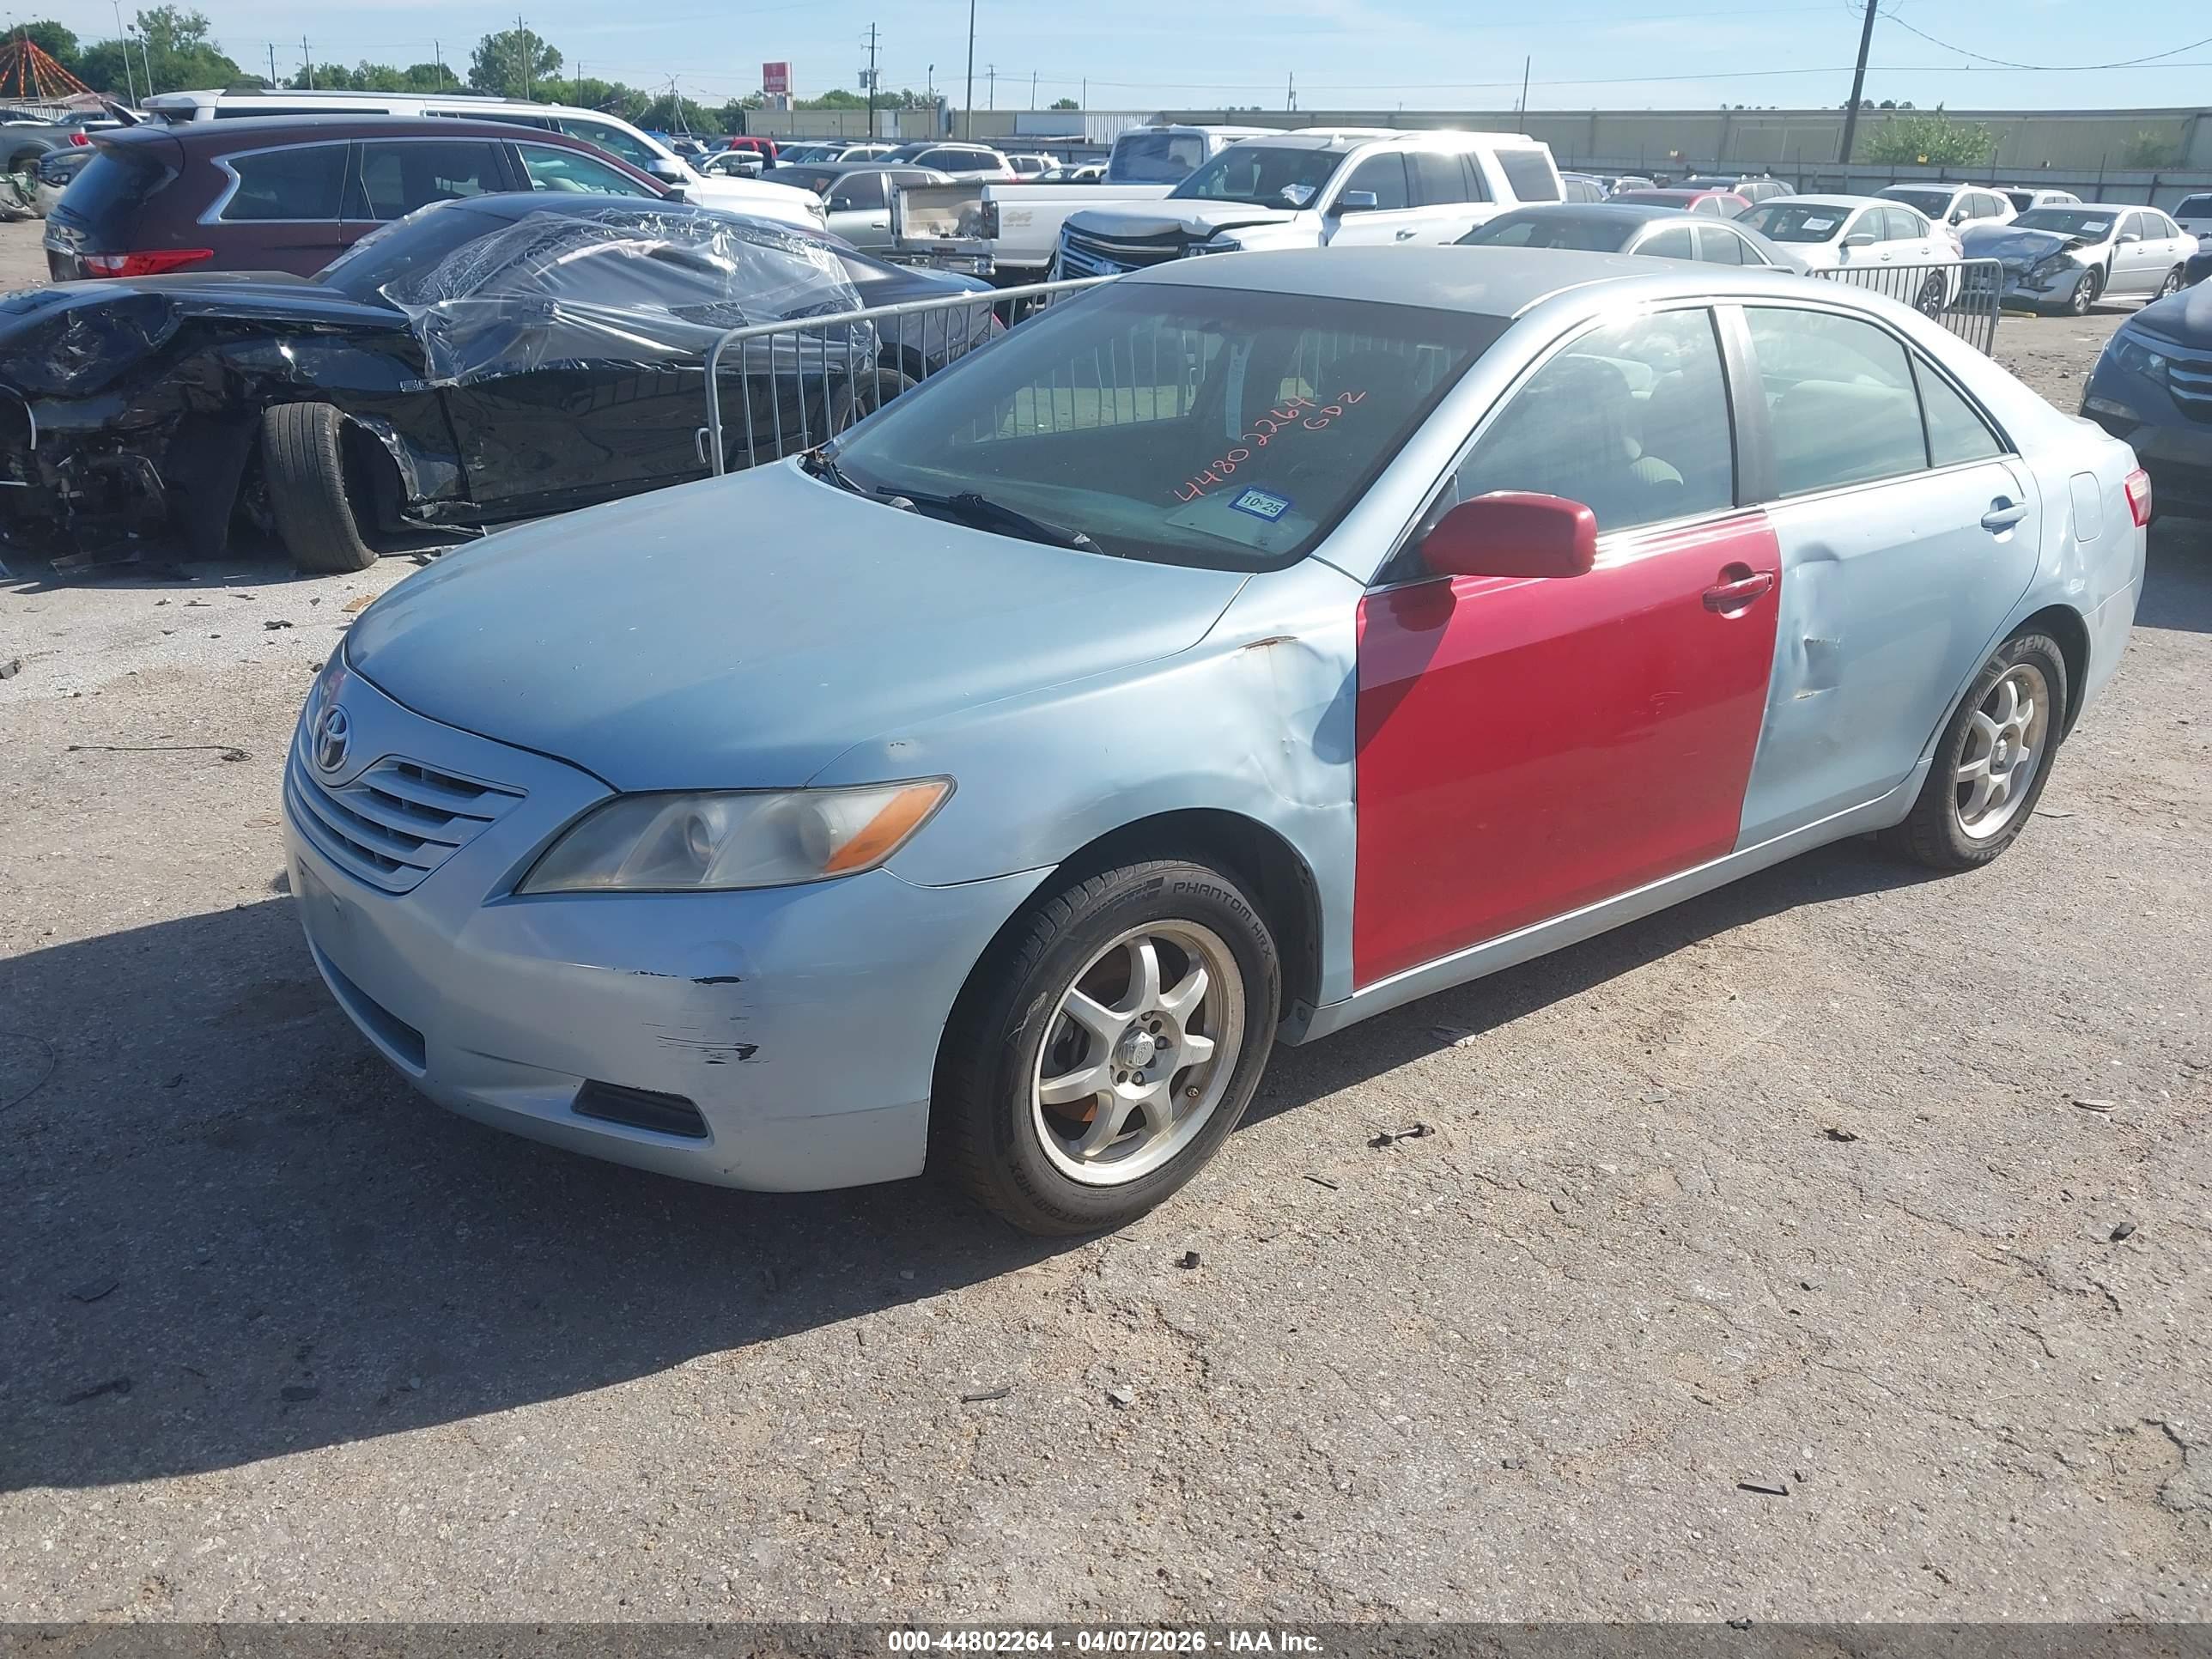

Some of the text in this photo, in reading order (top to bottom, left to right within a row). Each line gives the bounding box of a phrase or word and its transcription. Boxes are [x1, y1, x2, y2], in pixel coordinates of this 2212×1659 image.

[1174, 395, 1316, 501] 44802264
[1243, 495, 1259, 507] 10
[1261, 502, 1282, 514] 25
[1173, 881, 1272, 960] PHANTOM HRX
